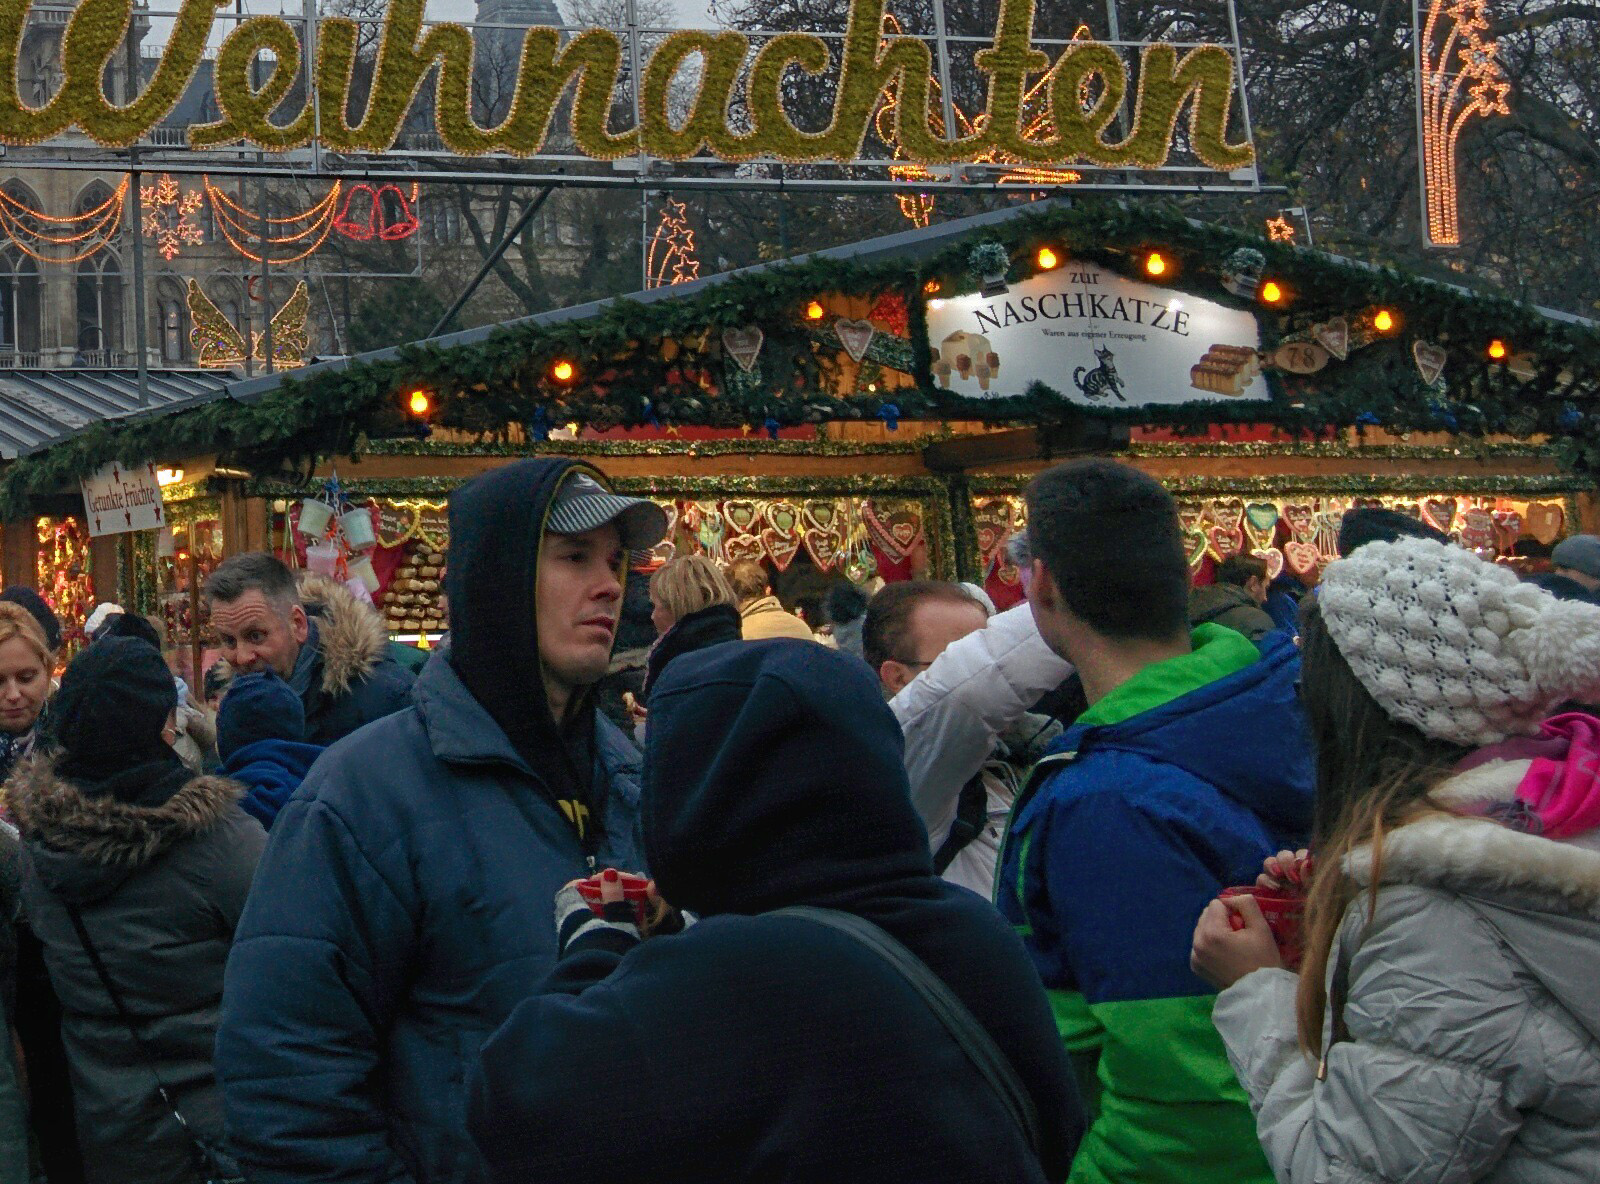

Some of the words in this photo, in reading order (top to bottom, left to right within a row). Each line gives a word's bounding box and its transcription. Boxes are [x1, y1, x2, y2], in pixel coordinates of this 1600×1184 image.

[1069, 271, 1100, 285] zur
[973, 292, 1191, 337] NASCHKATZE
[1042, 327, 1065, 337] Waren
[1288, 347, 1315, 368] 78
[87, 483, 124, 514] Getunkte
[122, 478, 155, 508] Früchte
